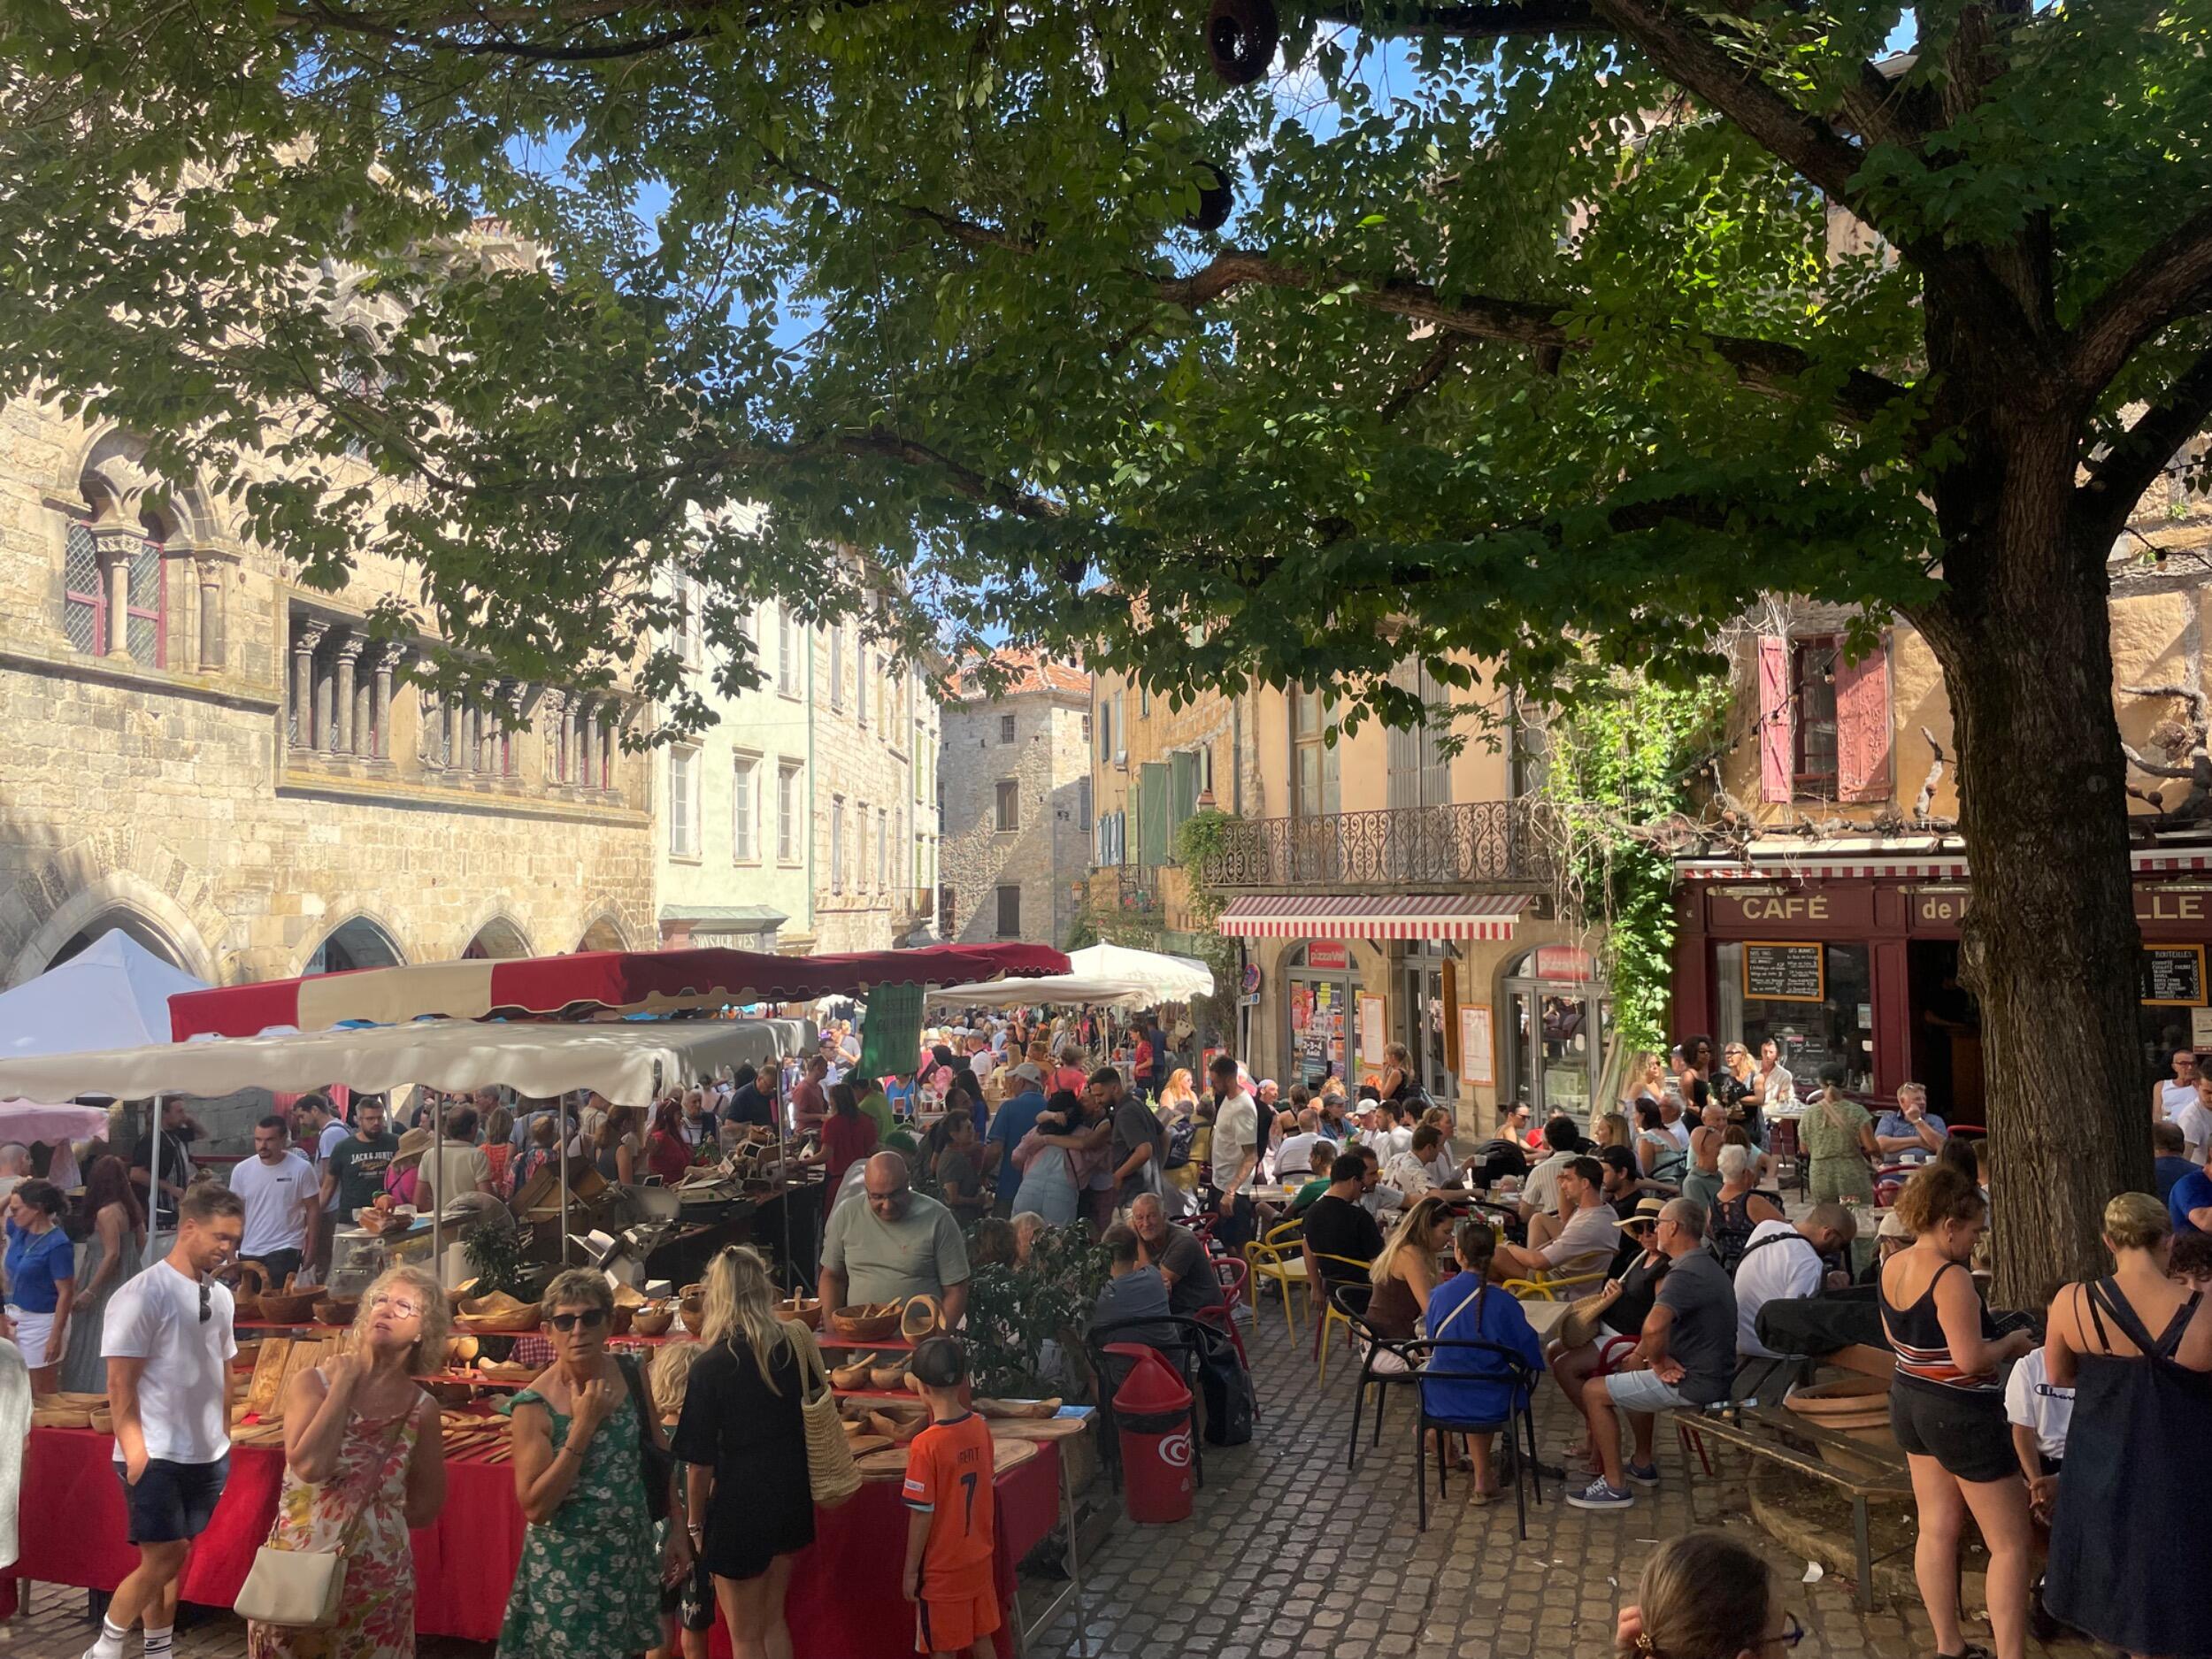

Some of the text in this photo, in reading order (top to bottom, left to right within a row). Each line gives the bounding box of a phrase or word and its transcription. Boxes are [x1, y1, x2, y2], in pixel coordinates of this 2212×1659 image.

[1742, 895, 1829, 919] CAFÉ
[1923, 897, 1952, 919] de
[350, 1152, 368, 1164] JACK
[960, 1472, 977, 1537] 7
